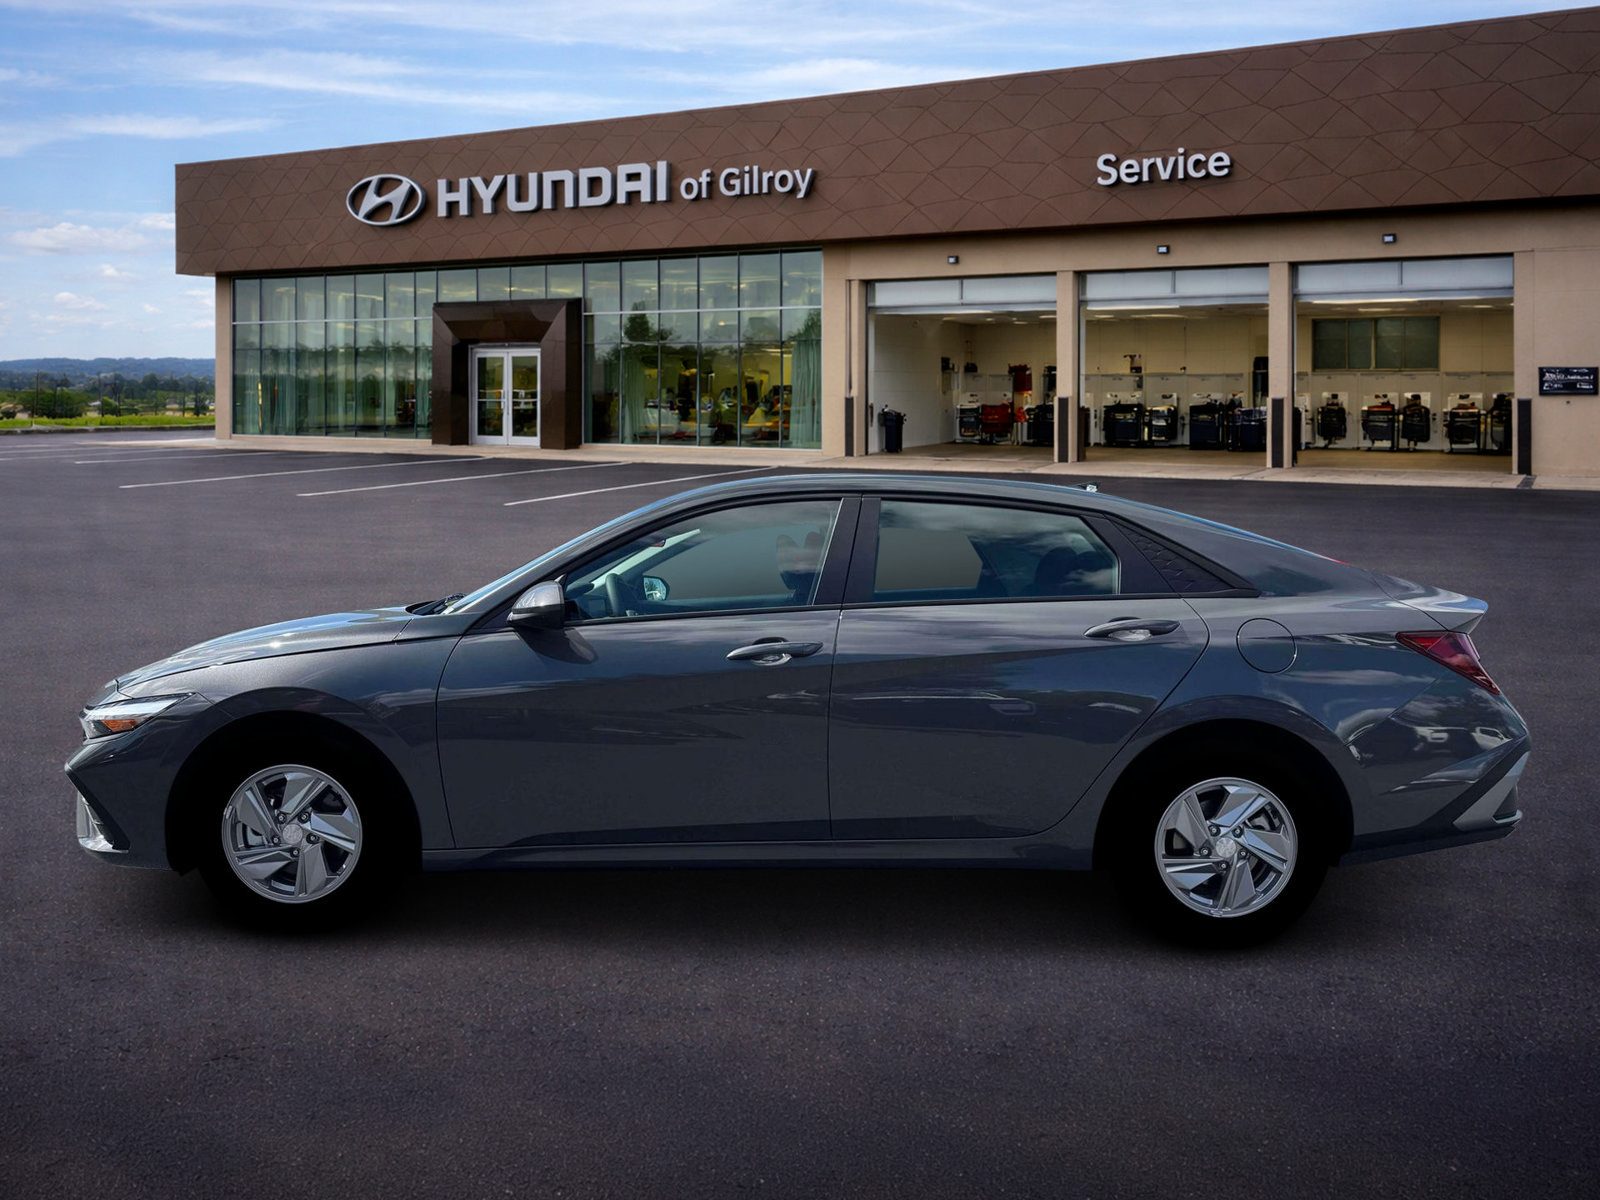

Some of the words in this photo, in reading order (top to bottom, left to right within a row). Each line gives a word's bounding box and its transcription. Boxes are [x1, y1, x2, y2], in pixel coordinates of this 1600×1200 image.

[437, 160, 670, 218] HYUNDAI
[680, 168, 712, 201] of
[718, 165, 813, 199] Gilroy
[1097, 147, 1231, 186] Service
